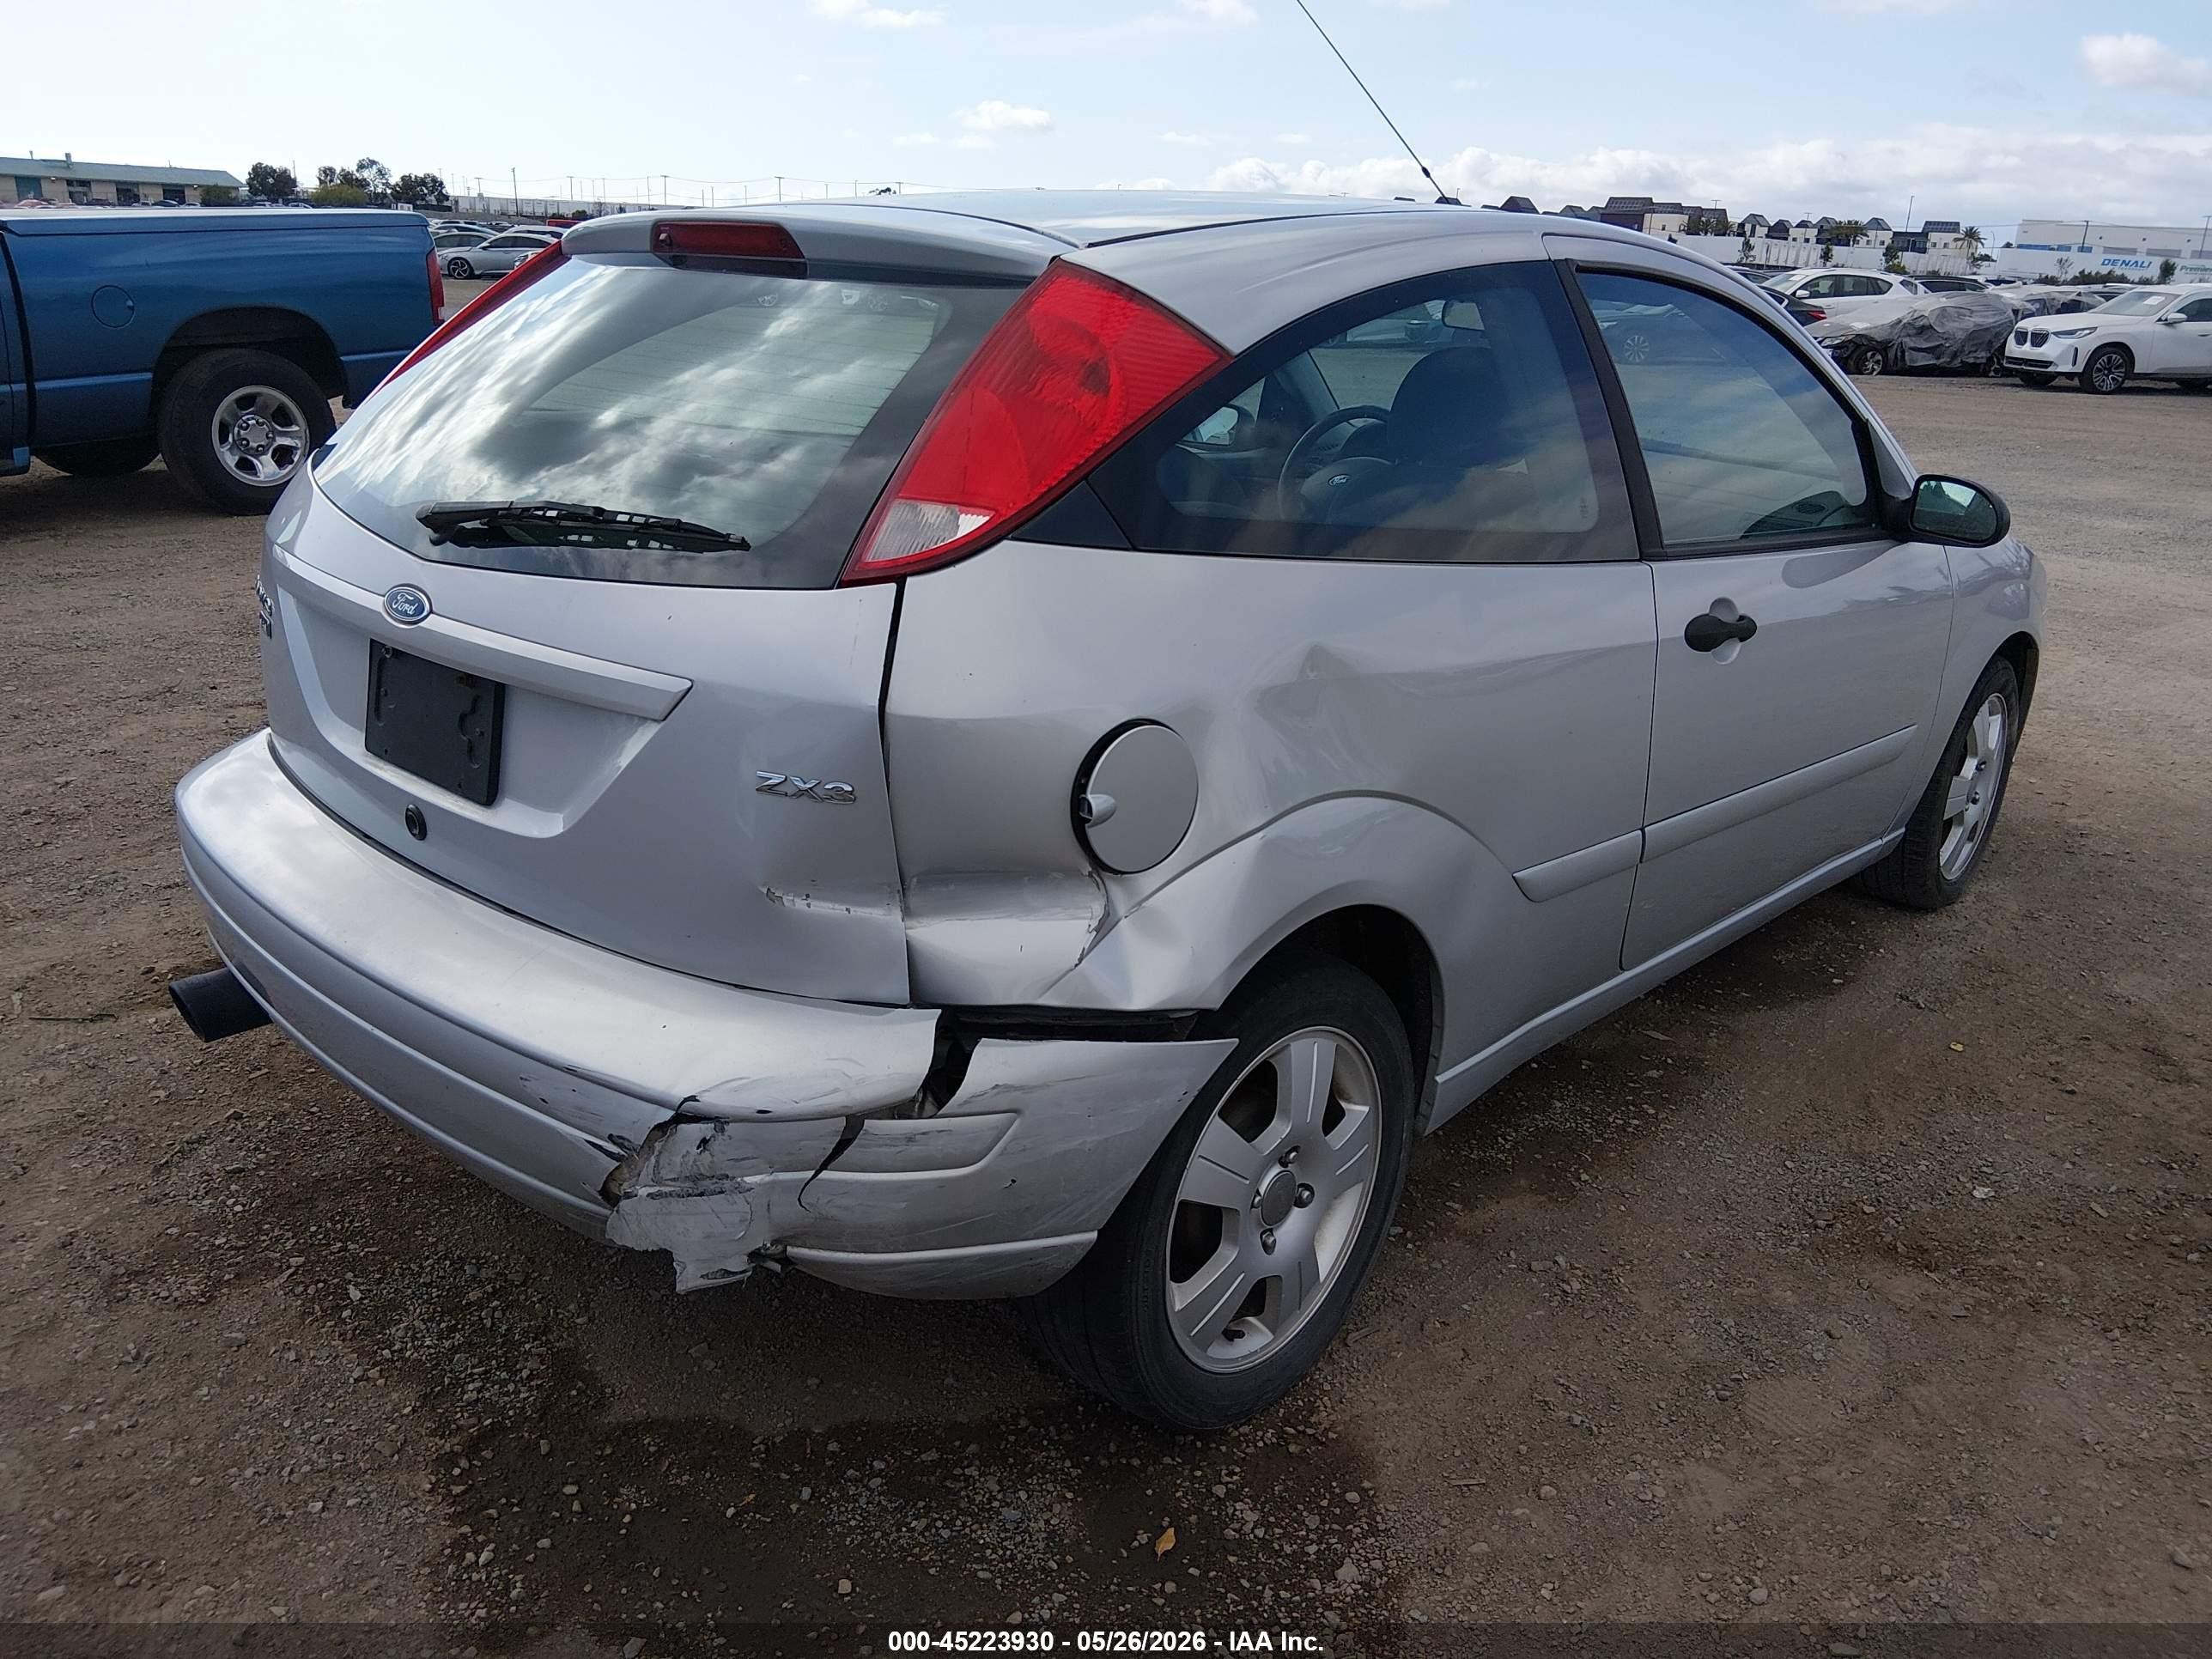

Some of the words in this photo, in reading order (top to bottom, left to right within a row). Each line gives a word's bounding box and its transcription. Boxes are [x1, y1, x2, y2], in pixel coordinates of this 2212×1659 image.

[2100, 258, 2153, 269] DENALI
[391, 591, 419, 616] Ford
[755, 769, 857, 805] ZX3
